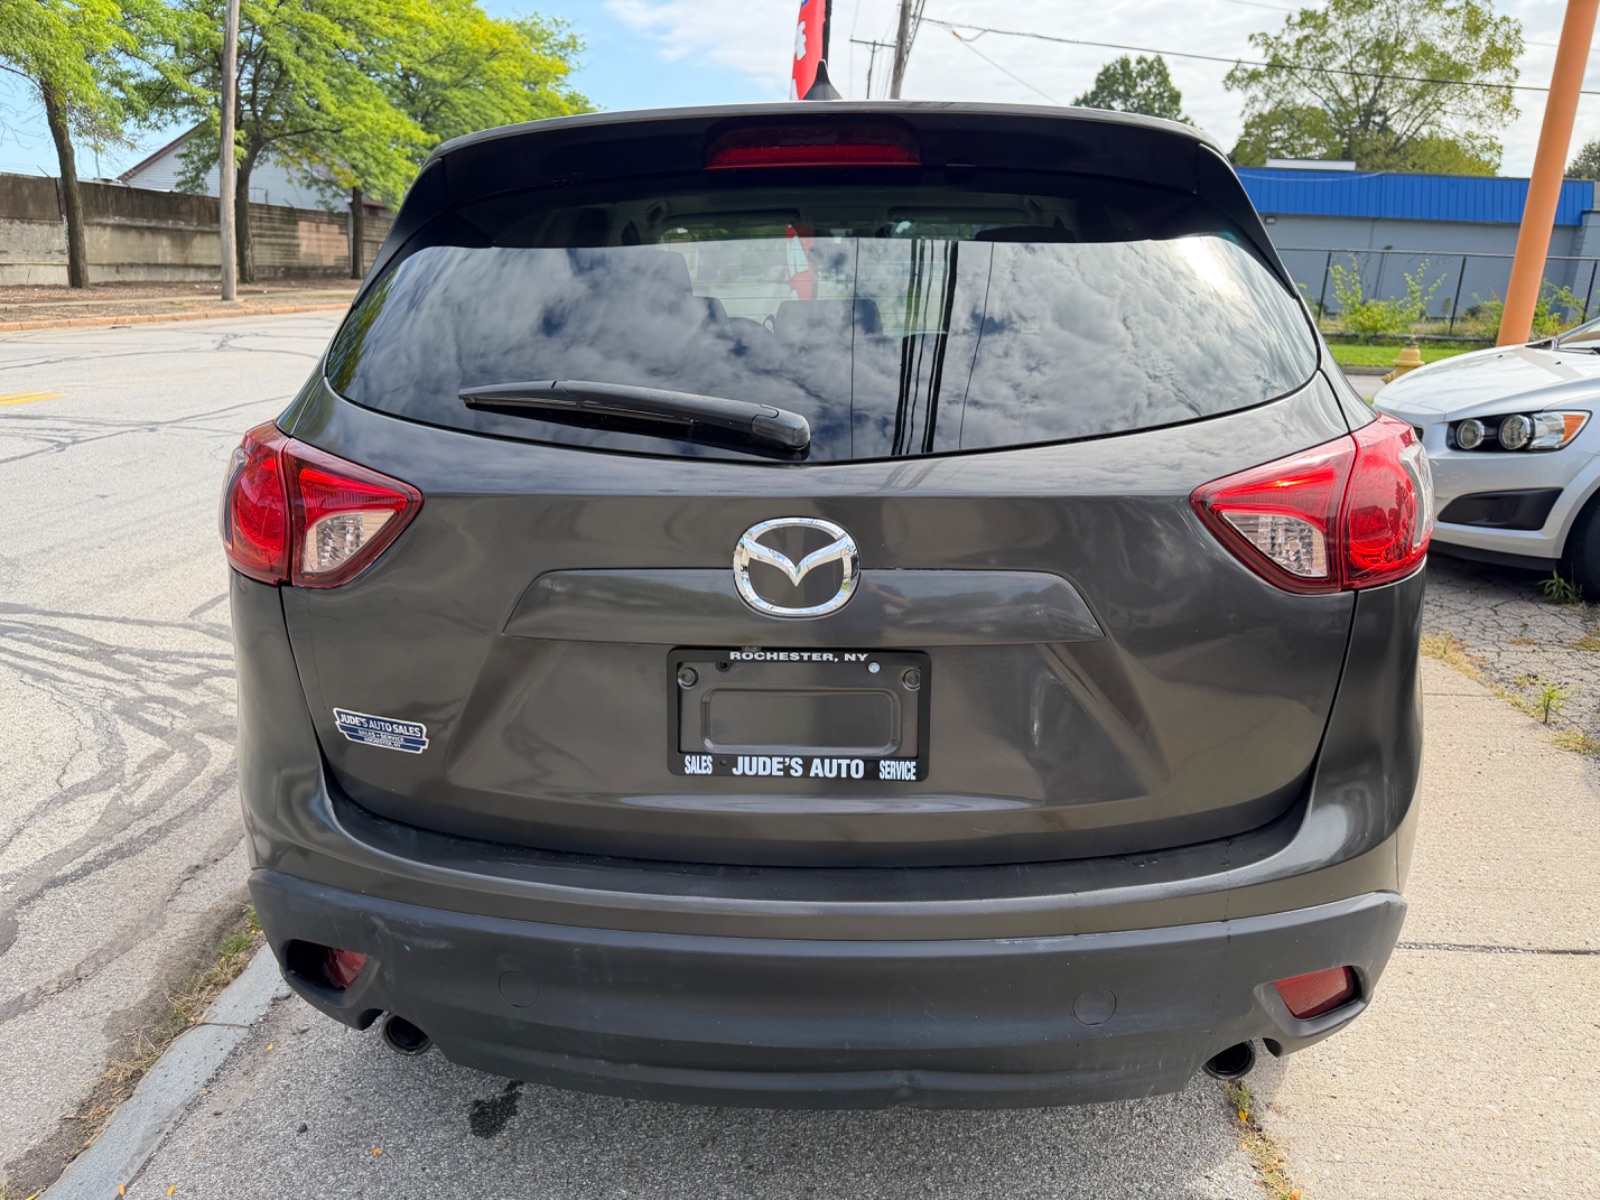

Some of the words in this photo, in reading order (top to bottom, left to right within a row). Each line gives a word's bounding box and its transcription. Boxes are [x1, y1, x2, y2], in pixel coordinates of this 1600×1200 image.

[729, 651, 839, 662] ROCHESTER,
[844, 653, 869, 662] NY
[340, 713, 368, 727] JUDE'S
[369, 720, 392, 732] AUTO
[393, 724, 421, 737] SALES
[684, 754, 713, 775] SALES
[732, 755, 804, 777] JUDE'S
[809, 758, 865, 779] AUTO
[879, 759, 917, 781] SERVICE
